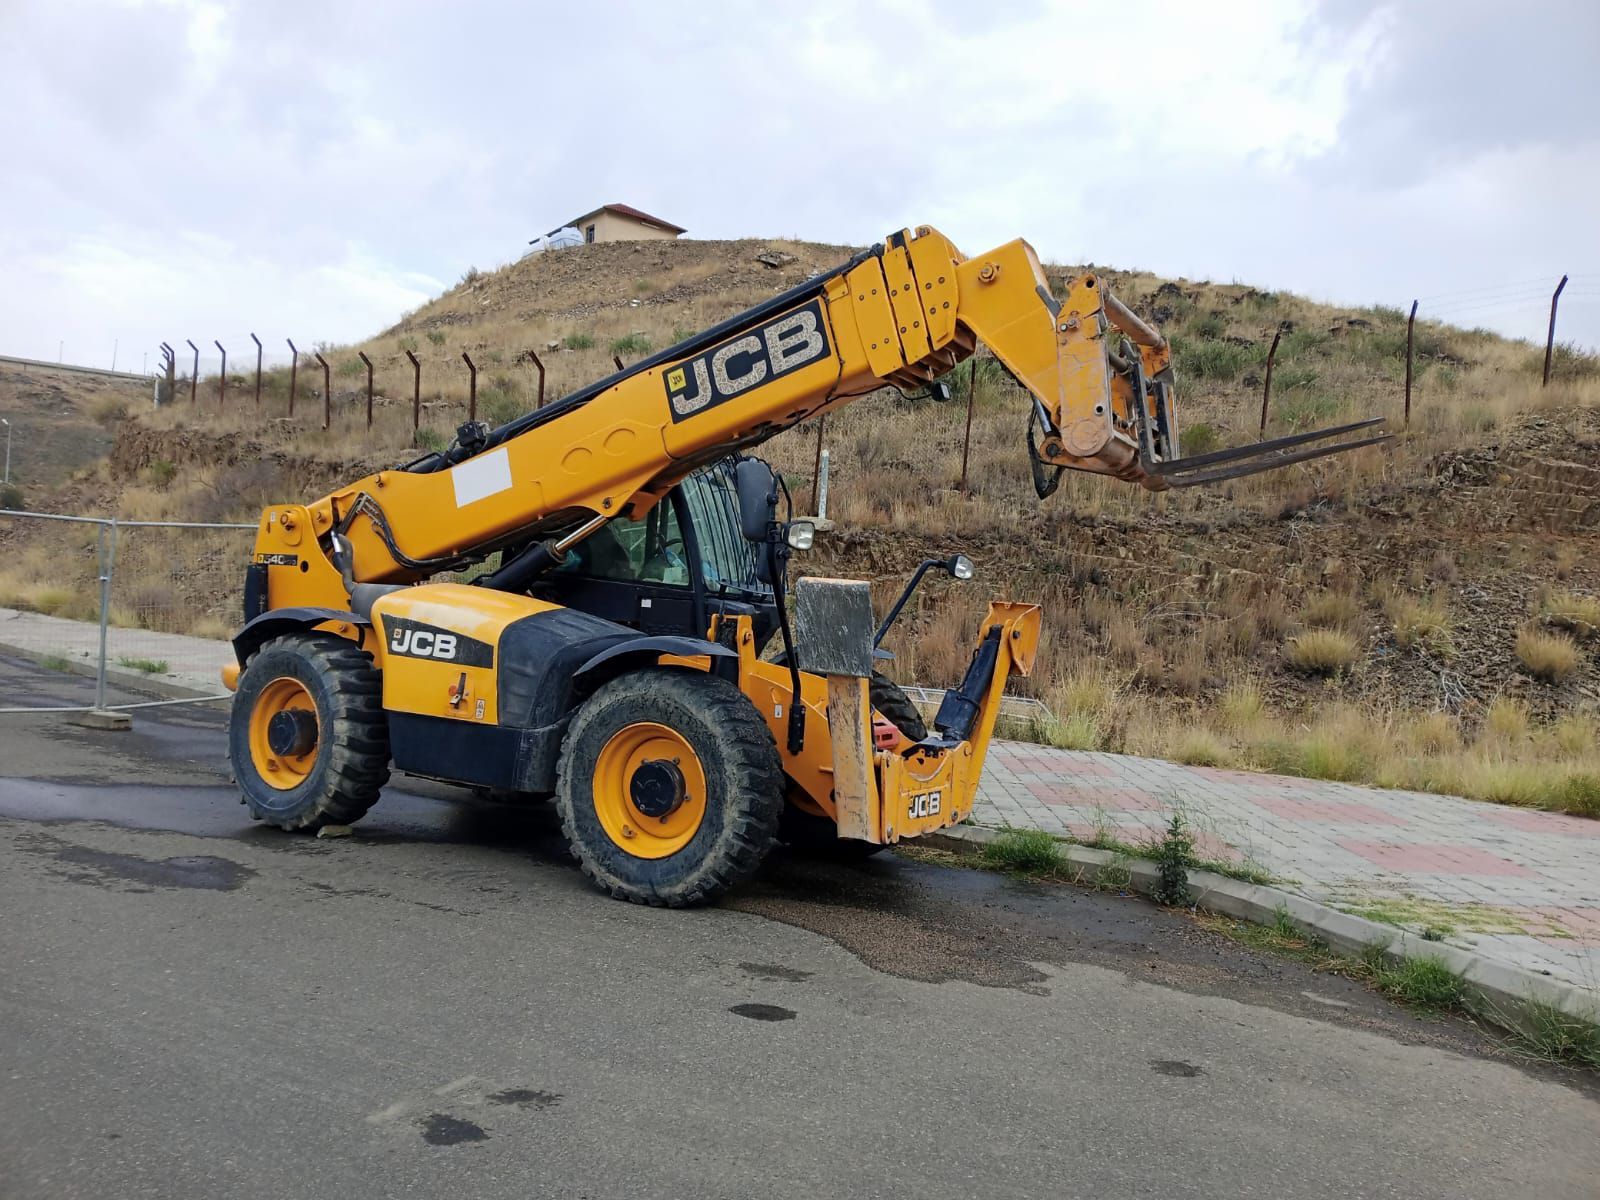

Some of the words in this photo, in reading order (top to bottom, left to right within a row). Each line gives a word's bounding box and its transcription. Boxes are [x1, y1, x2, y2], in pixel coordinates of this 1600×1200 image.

[672, 310, 824, 415] JCB
[391, 629, 457, 659] JCB
[908, 791, 941, 819] JCB
